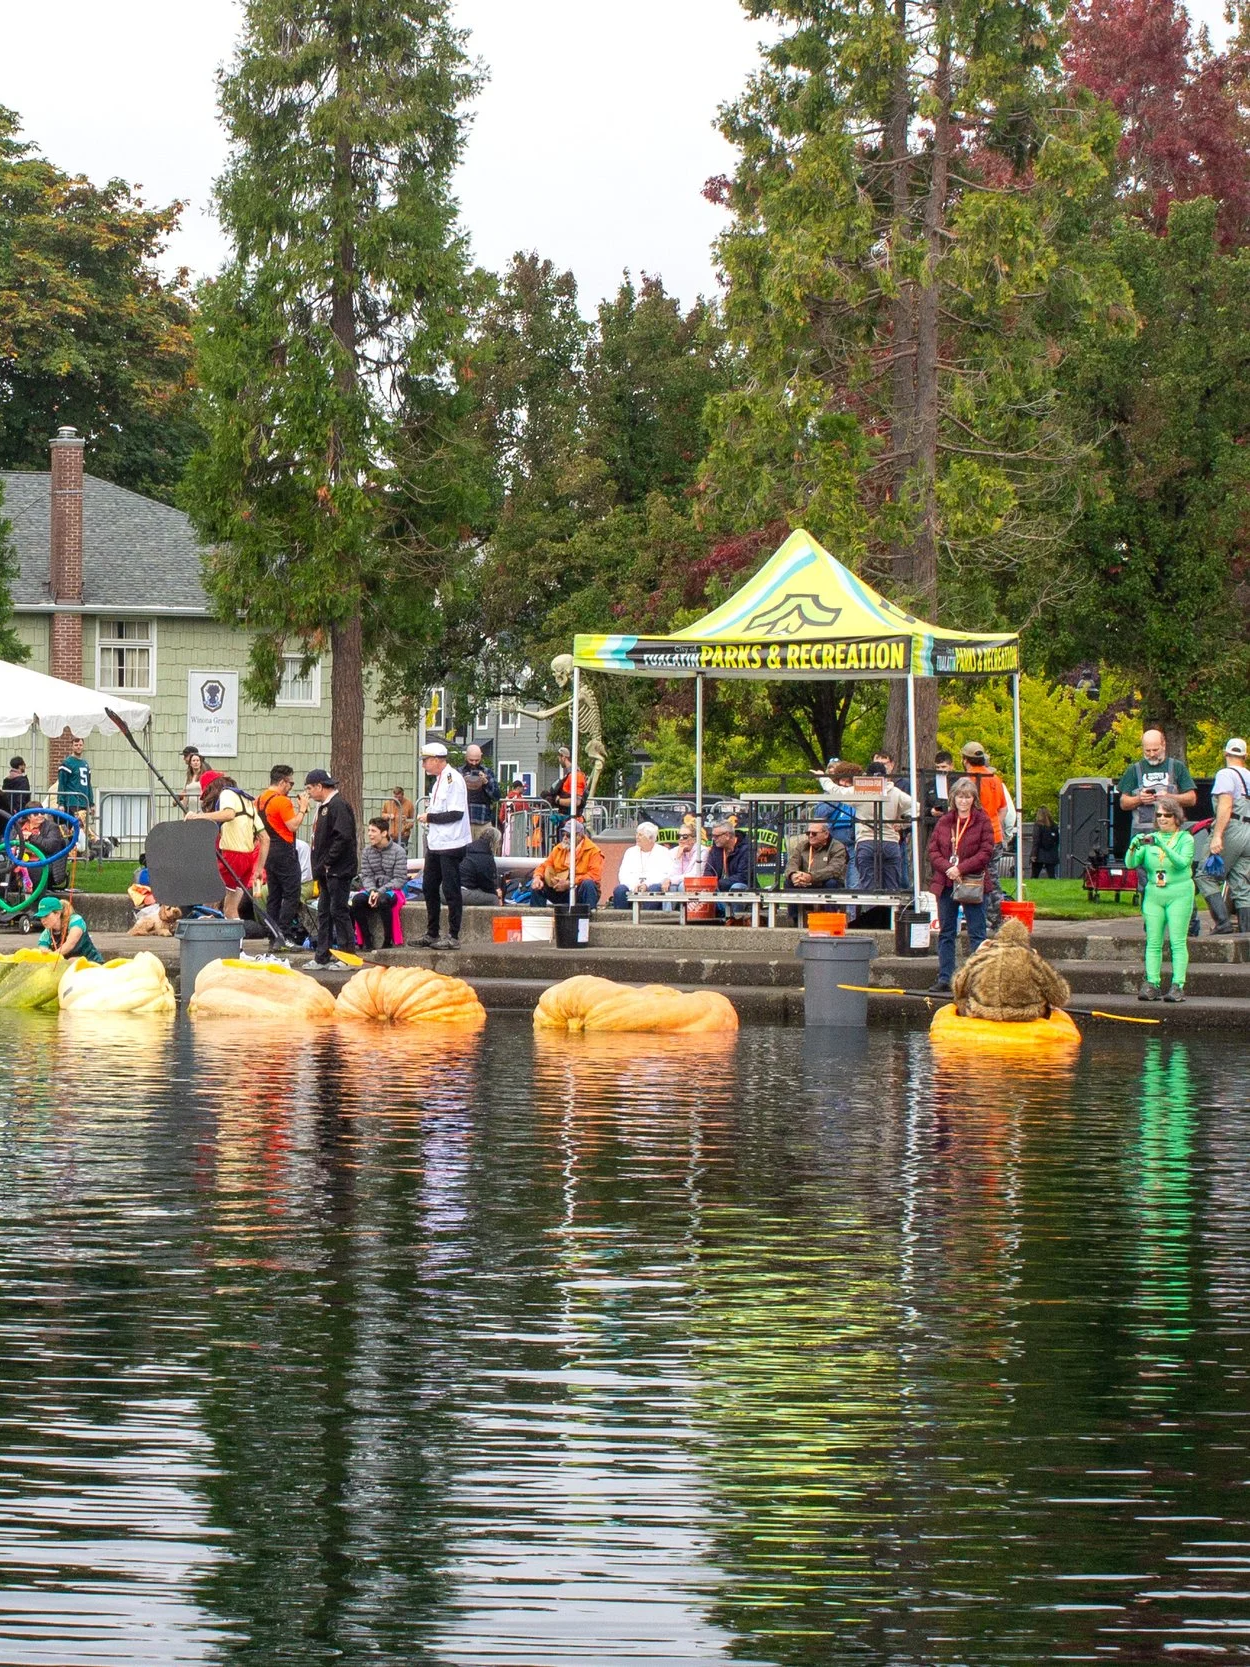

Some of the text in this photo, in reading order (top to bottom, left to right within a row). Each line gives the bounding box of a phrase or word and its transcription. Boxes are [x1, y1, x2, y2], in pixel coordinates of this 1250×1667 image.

[643, 642, 904, 670] TUALATIN PARKS & RECREATION
[213, 717, 234, 726] Grange
[79, 767, 88, 786] 5
